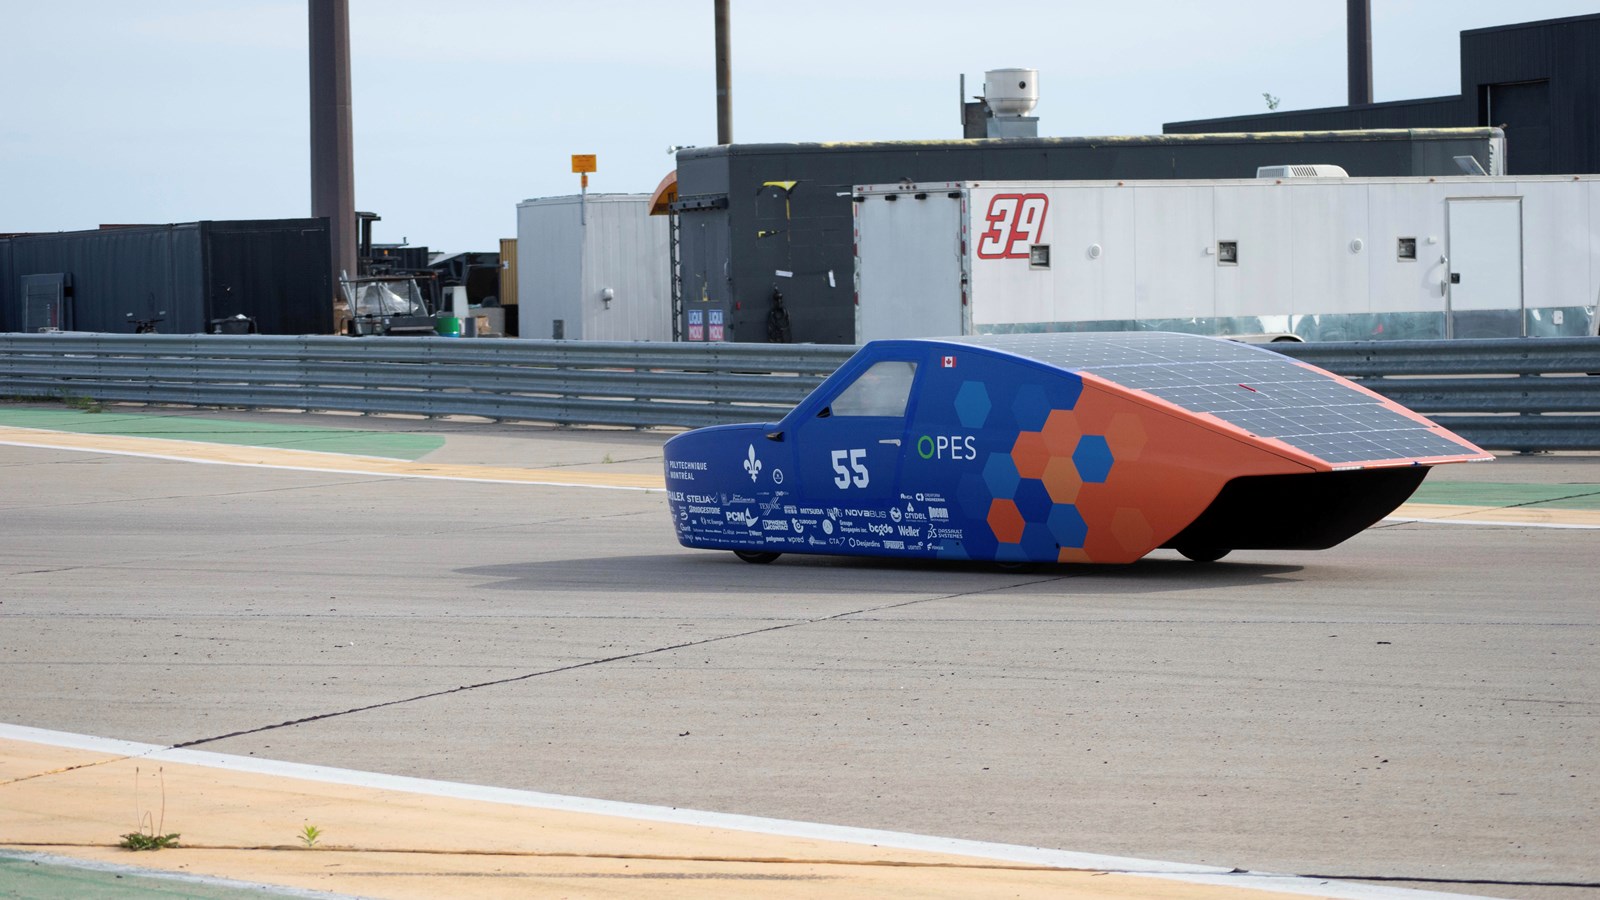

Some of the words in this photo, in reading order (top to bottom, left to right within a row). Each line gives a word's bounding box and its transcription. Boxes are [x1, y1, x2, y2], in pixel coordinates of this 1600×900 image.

[977, 193, 1049, 259] 39
[917, 435, 977, 460] OPES
[669, 460, 708, 470] POLYTECHNIQUE
[831, 448, 870, 490] 55
[670, 471, 695, 480] MONTRÉAL
[686, 494, 712, 504] STELIA
[725, 511, 747, 522] PCM
[897, 525, 920, 537] Weller
[856, 539, 881, 547] Desjardins
